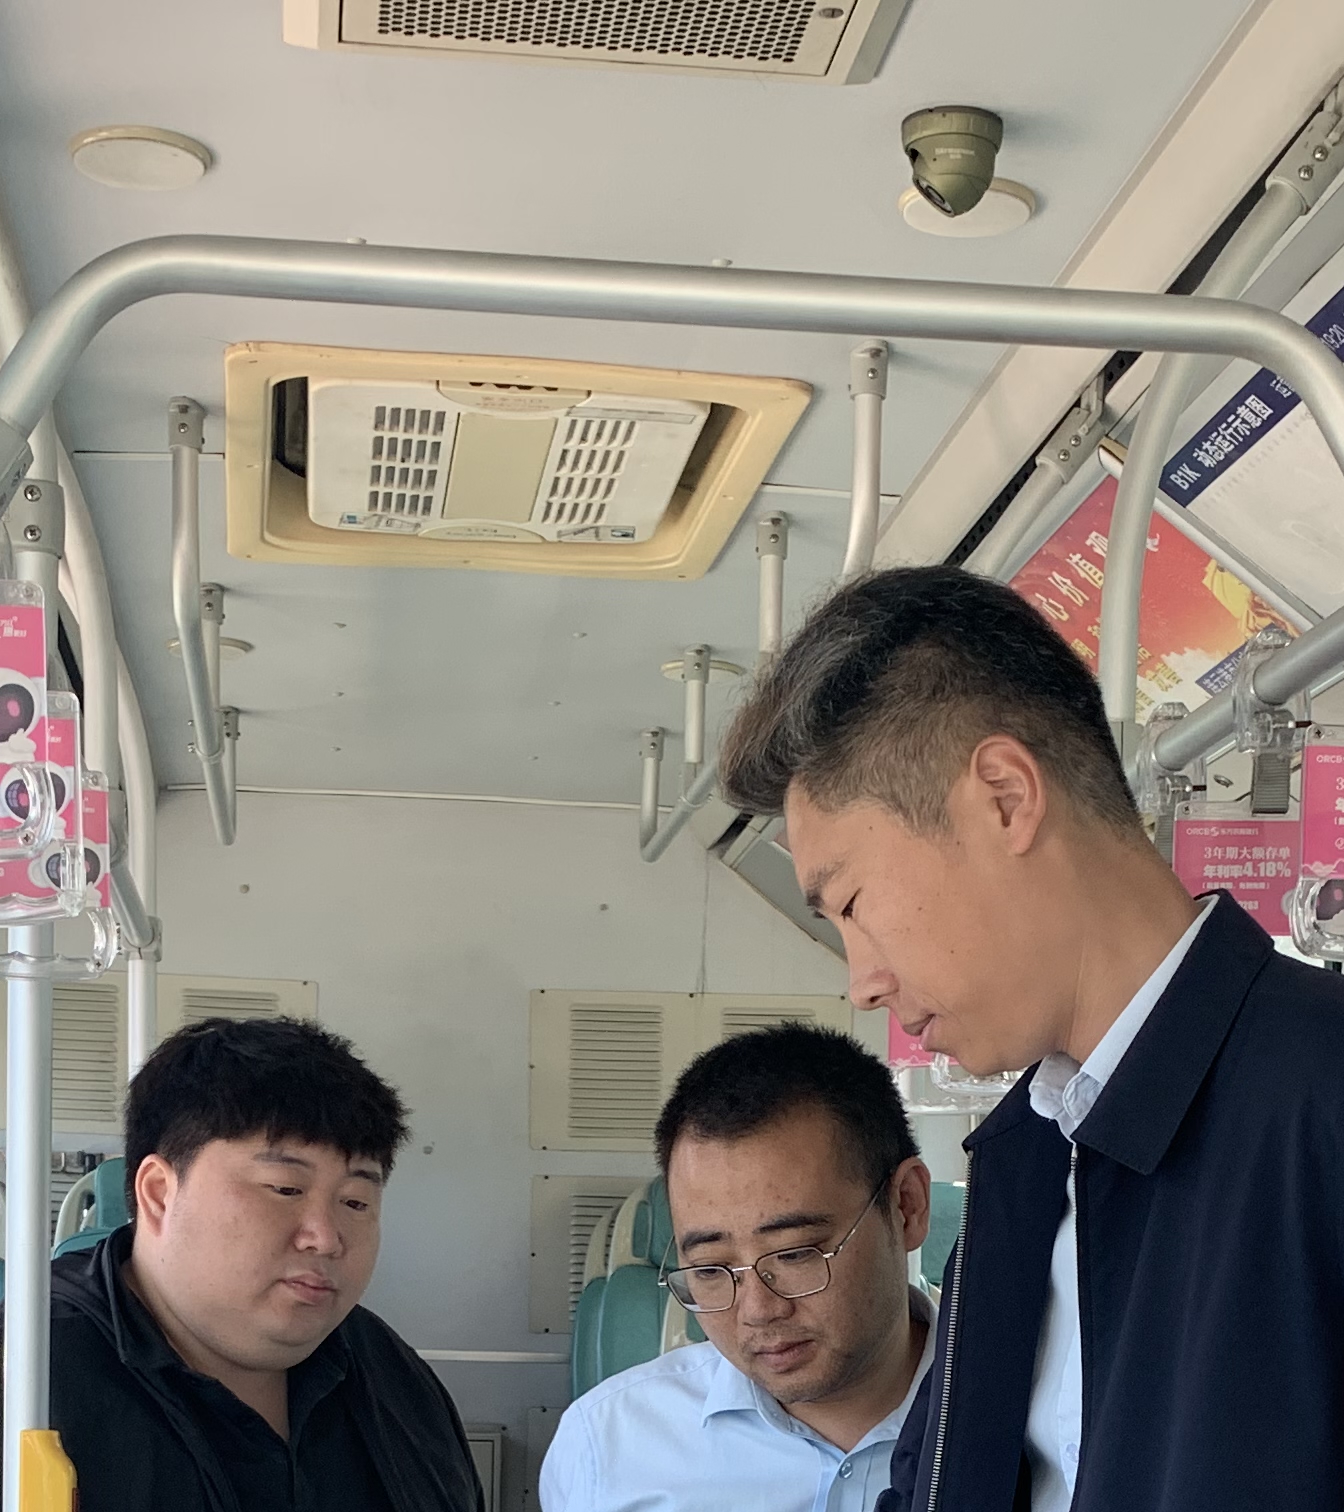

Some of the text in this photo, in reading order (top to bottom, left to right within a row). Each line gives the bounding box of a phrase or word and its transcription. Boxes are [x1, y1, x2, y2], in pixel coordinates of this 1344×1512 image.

[1169, 463, 1202, 490] B1K
[1192, 394, 1274, 468] 动态运行示意图
[1204, 846, 1291, 860] 3年期大额存单
[1203, 861, 1291, 878] 年利率4.18%
